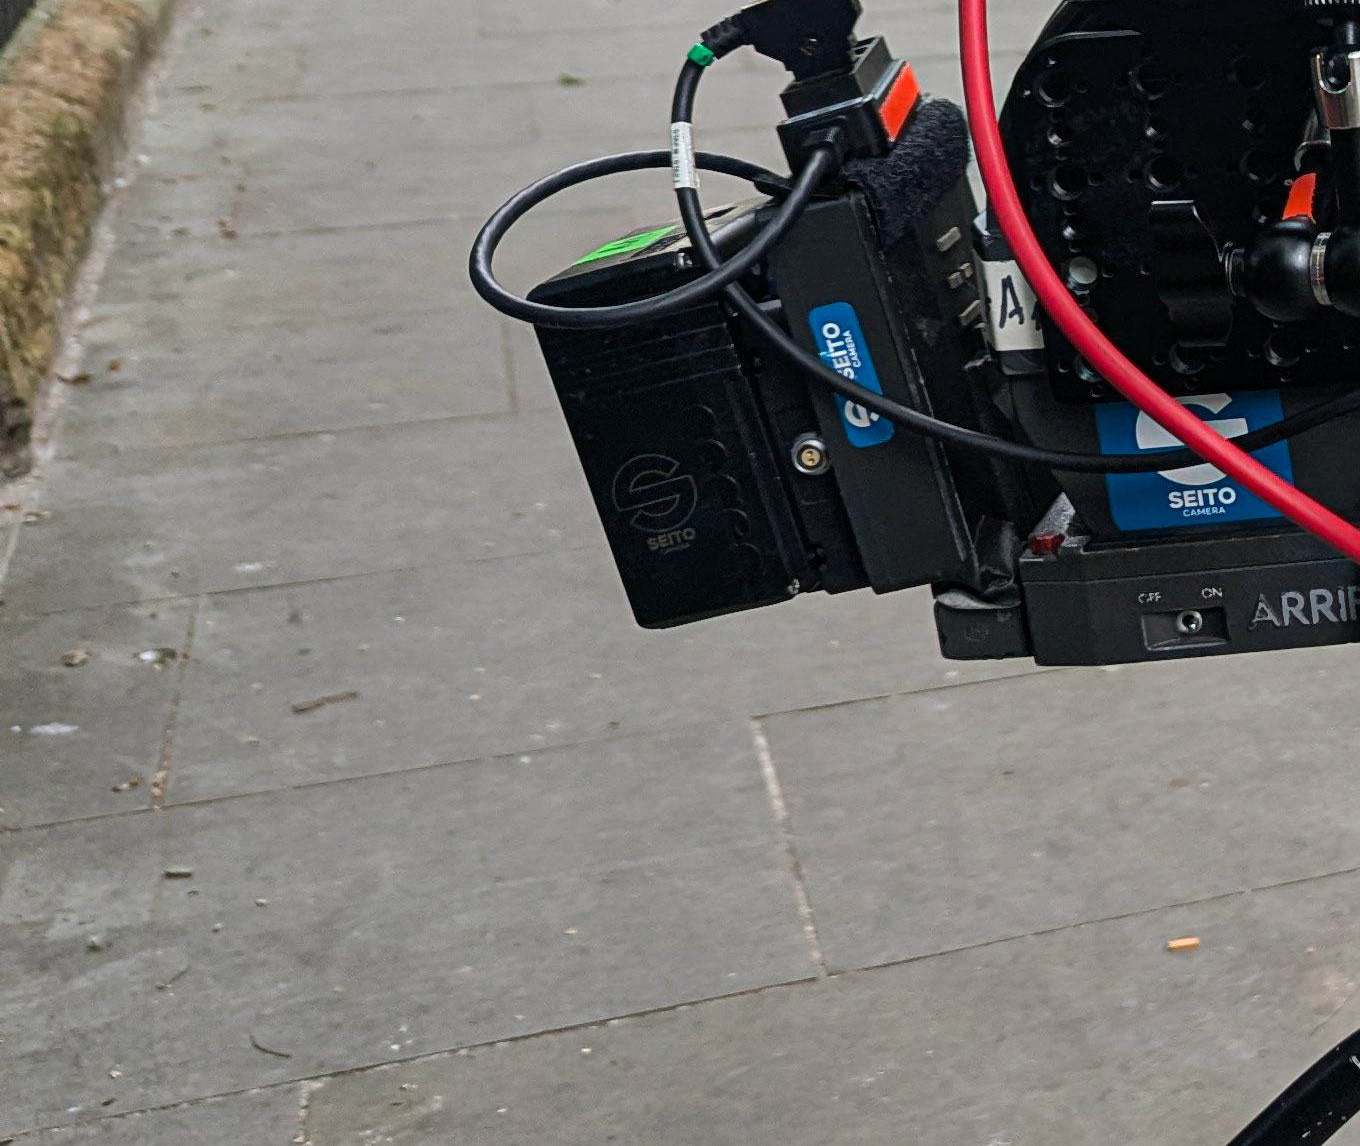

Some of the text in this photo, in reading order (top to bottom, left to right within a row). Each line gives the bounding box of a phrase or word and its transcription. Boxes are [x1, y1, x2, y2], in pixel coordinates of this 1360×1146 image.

[999, 274, 1024, 328] A
[822, 322, 855, 380] SEITO
[842, 330, 862, 368] CAMERA
[1168, 486, 1236, 508] SEITO
[1182, 506, 1226, 517] CAMERA
[648, 528, 696, 551] SEITO
[1138, 592, 1161, 604] OFF
[1202, 588, 1222, 598] ON
